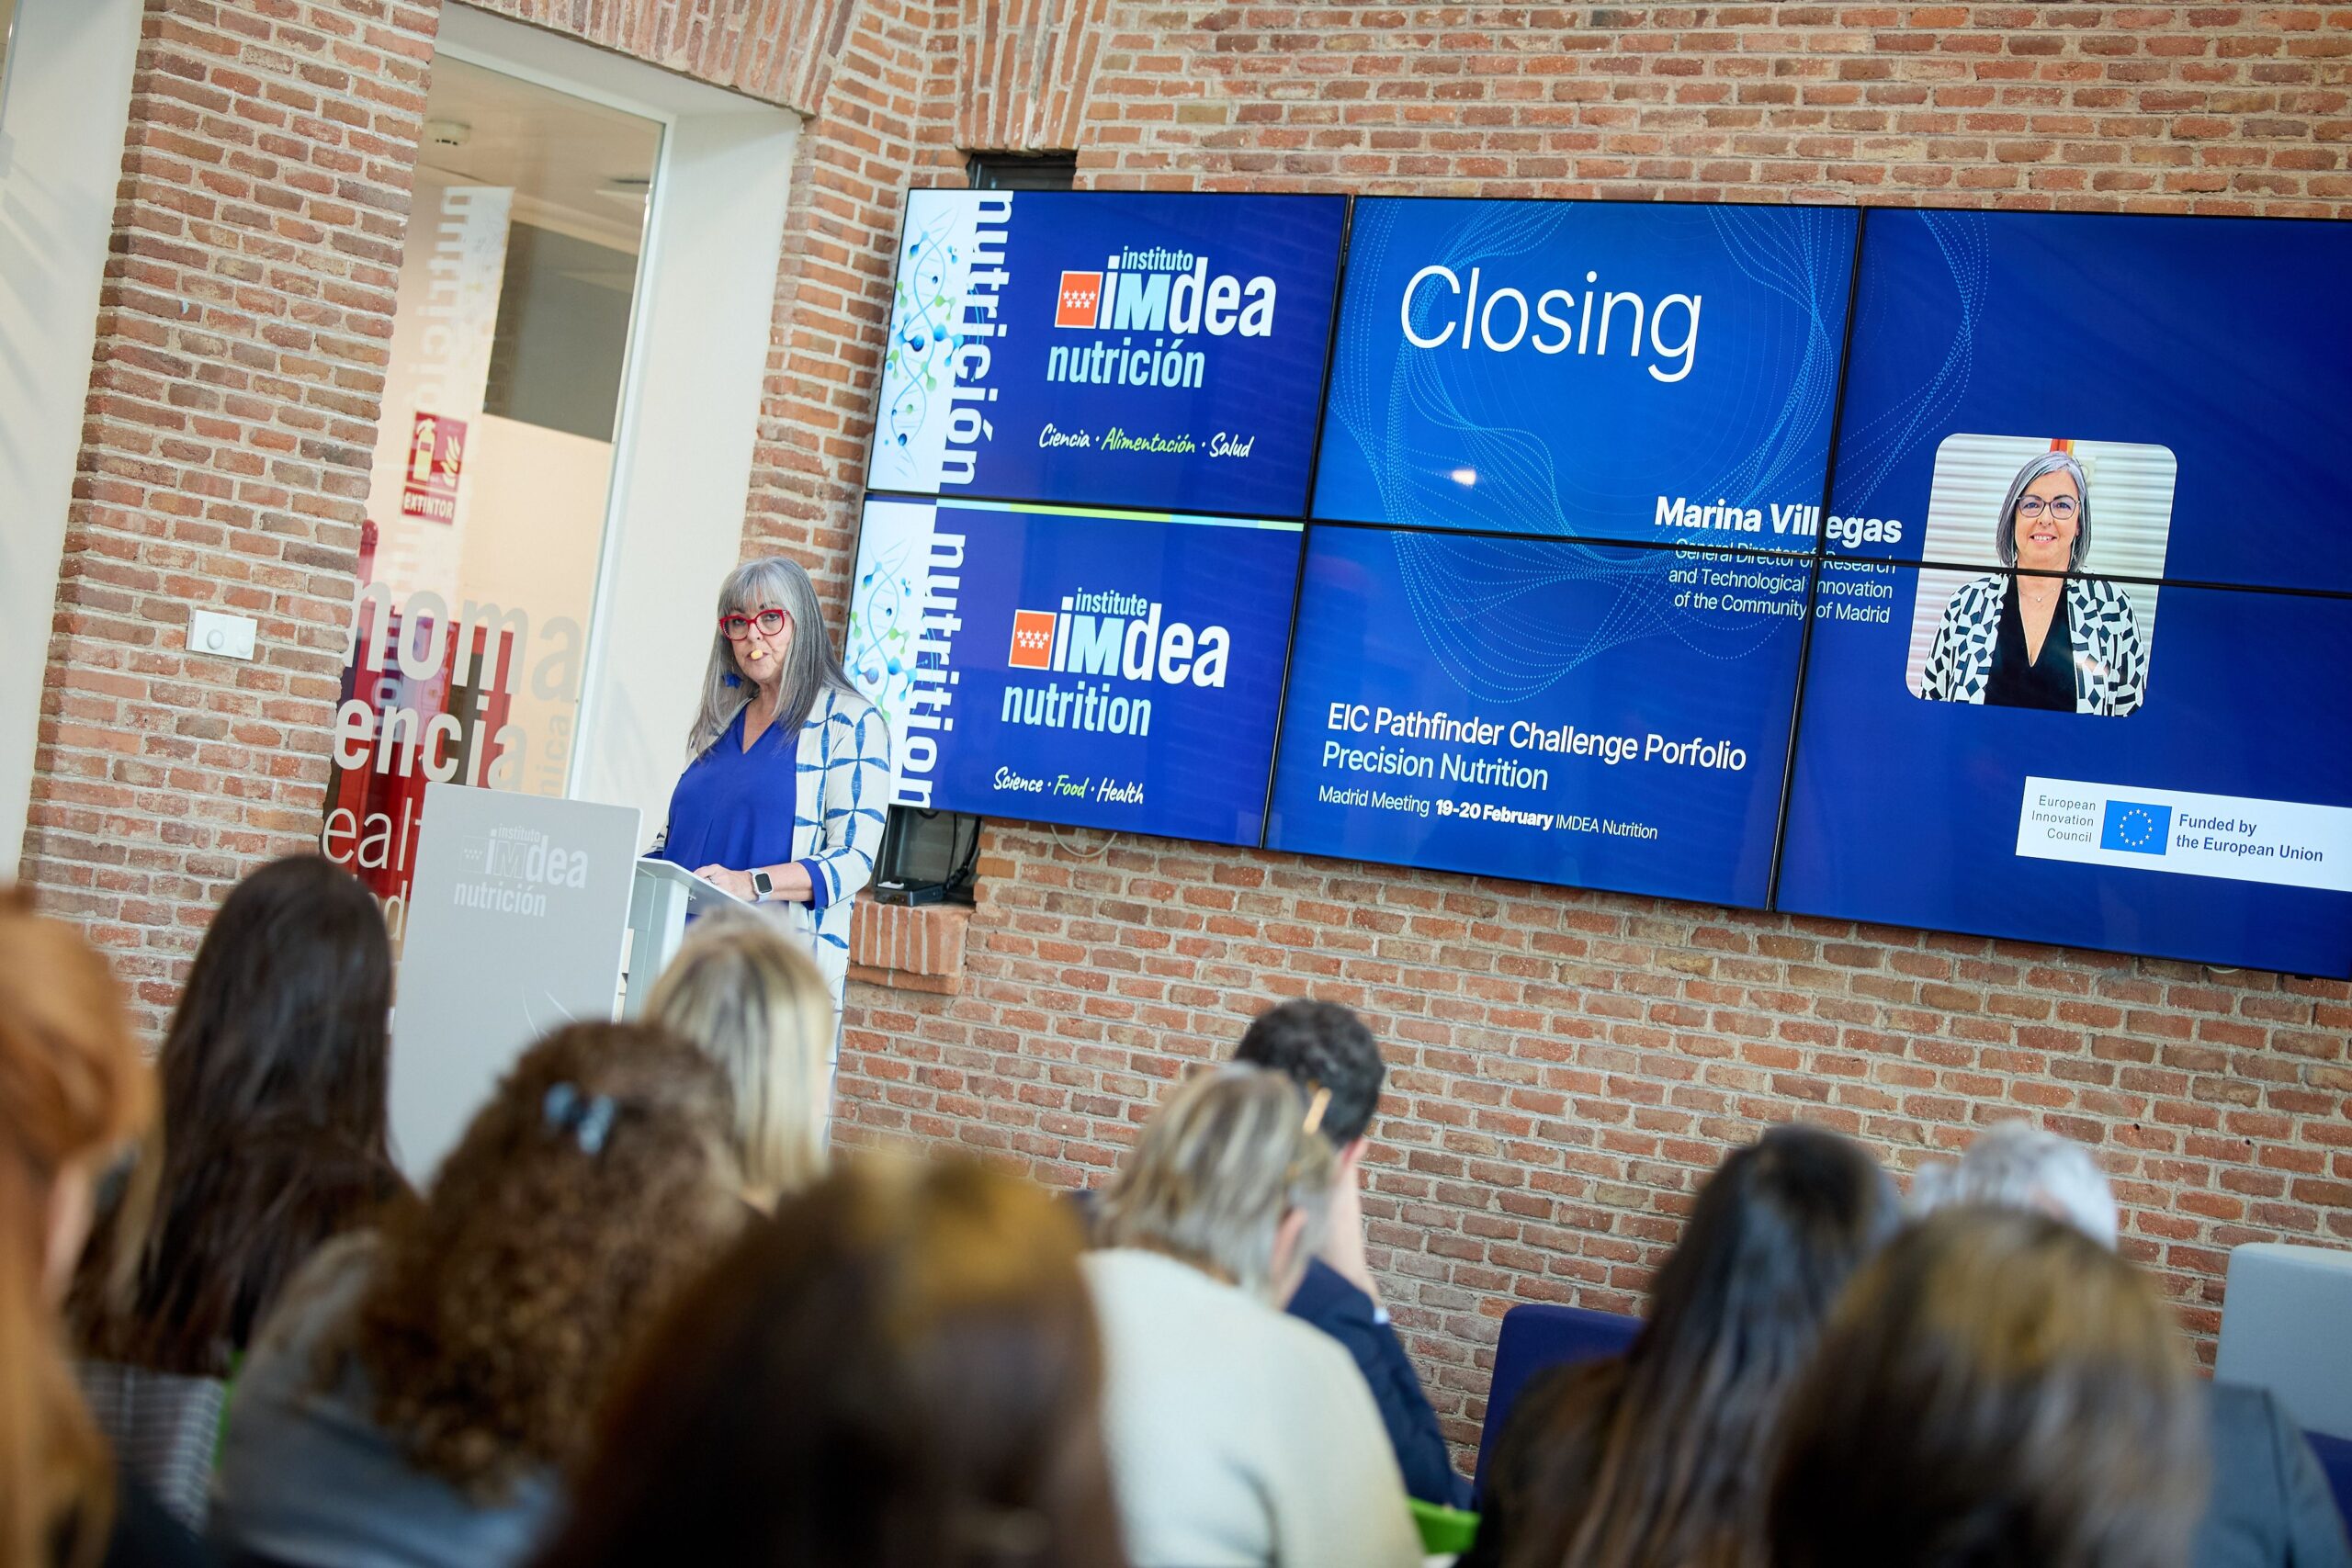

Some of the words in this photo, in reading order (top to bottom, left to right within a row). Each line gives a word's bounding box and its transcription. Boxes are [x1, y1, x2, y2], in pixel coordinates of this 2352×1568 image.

[1122, 245, 1193, 272] instituto
[940, 190, 1013, 486] nutrición
[1400, 265, 1702, 383] Closing
[1046, 337, 1205, 388] nutrición
[1038, 423, 1091, 448] Ciencia
[1101, 426, 1196, 454] Alimentación
[1208, 432, 1254, 458] Salud
[404, 491, 454, 519] EXTINTOR
[1654, 495, 1762, 533] Marina
[1770, 503, 1903, 548] Villegas
[1668, 568, 1698, 584] and
[1701, 569, 1805, 594] Technological
[1816, 580, 1893, 599] nnovation
[1075, 587, 1148, 617] institute
[1674, 591, 1692, 607] of
[1693, 592, 1717, 611] the
[1721, 594, 1807, 620] Community
[1815, 602, 1833, 619] of
[1836, 603, 1891, 624] Madrid
[897, 533, 967, 808] nutrition
[1001, 681, 1151, 737] nutrition
[1327, 702, 1370, 732] EIC
[1374, 706, 1505, 746] Pathfinder
[1509, 720, 1638, 765] Challenge
[1644, 733, 1747, 772] Porfolio
[1322, 741, 1434, 779] Precision
[1439, 752, 1548, 790] Nutrition
[993, 766, 1043, 794] Science
[1053, 776, 1086, 799] Food
[1097, 777, 1144, 805] Health
[2038, 795, 2097, 811] European
[1318, 785, 1369, 807] Madrid
[1371, 791, 1430, 818] Meeting
[1435, 799, 1481, 820] 19-20
[1482, 804, 1554, 830] February
[1555, 814, 1600, 833] IMDEA
[1601, 818, 1658, 840] Nutrition
[2031, 810, 2095, 827] Innovation
[2178, 814, 2234, 832] Funded
[2238, 819, 2257, 837] by
[322, 797, 422, 872] eal
[498, 824, 541, 843] instituto
[2046, 829, 2092, 843] Council
[2176, 834, 2199, 850] the
[2203, 838, 2275, 858] European
[2279, 844, 2324, 863] Union
[454, 881, 547, 918] nutrición
